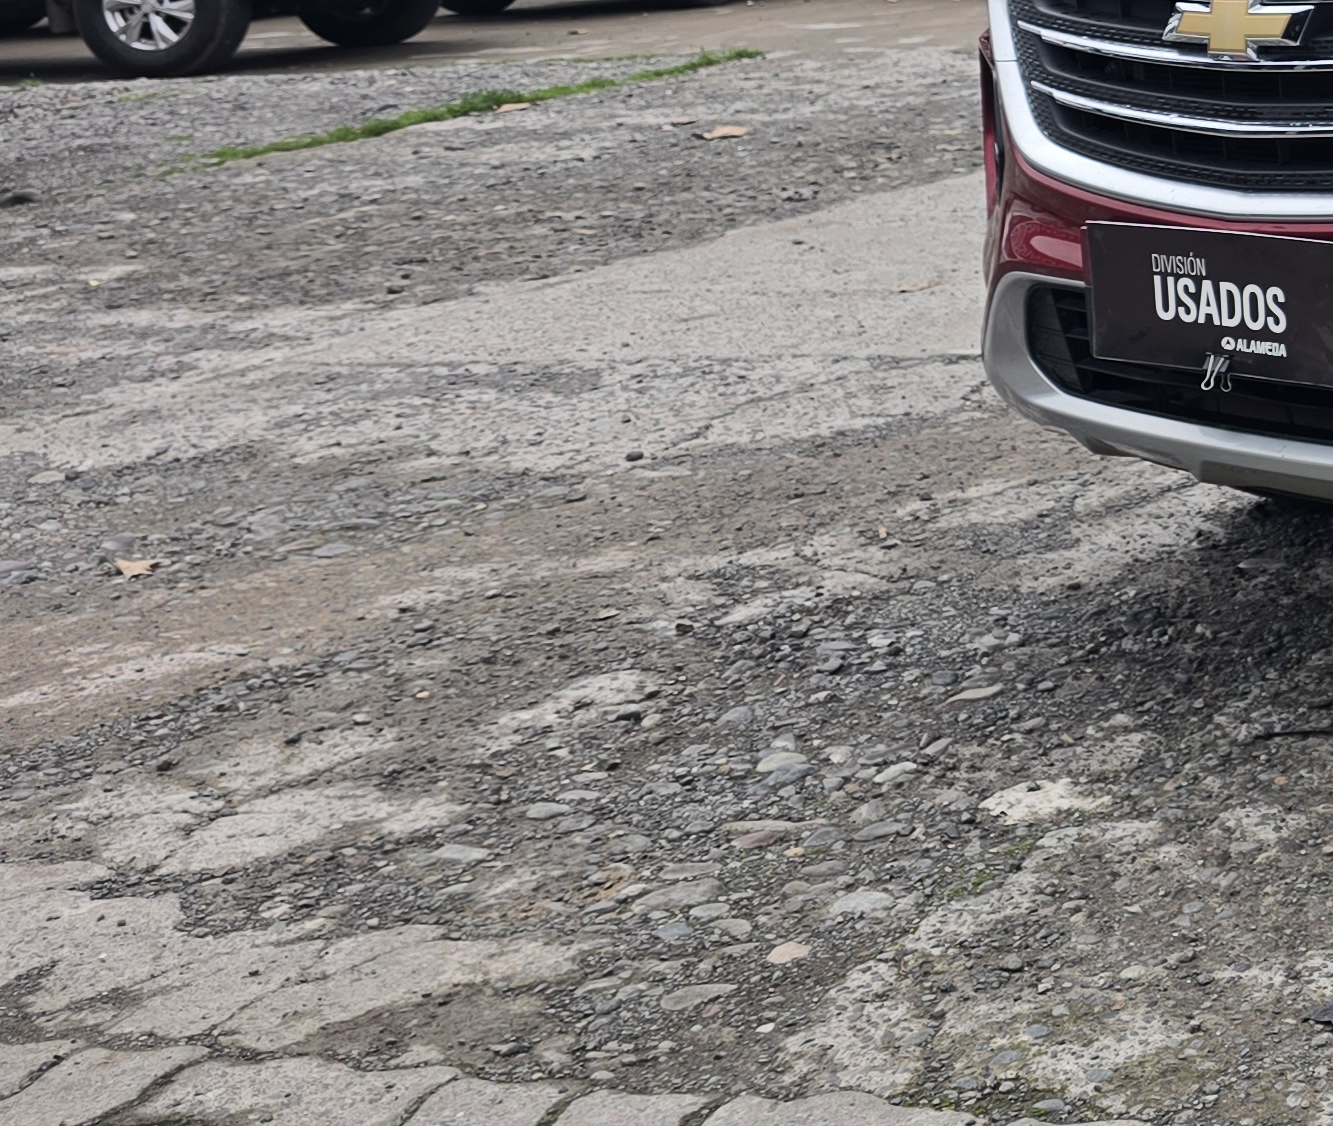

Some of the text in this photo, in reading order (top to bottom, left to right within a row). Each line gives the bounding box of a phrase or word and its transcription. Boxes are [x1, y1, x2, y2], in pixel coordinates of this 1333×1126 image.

[1151, 252, 1206, 276] DIVISIÓN
[1153, 274, 1287, 334] USADOS
[1236, 338, 1287, 358] ALAMEDA
